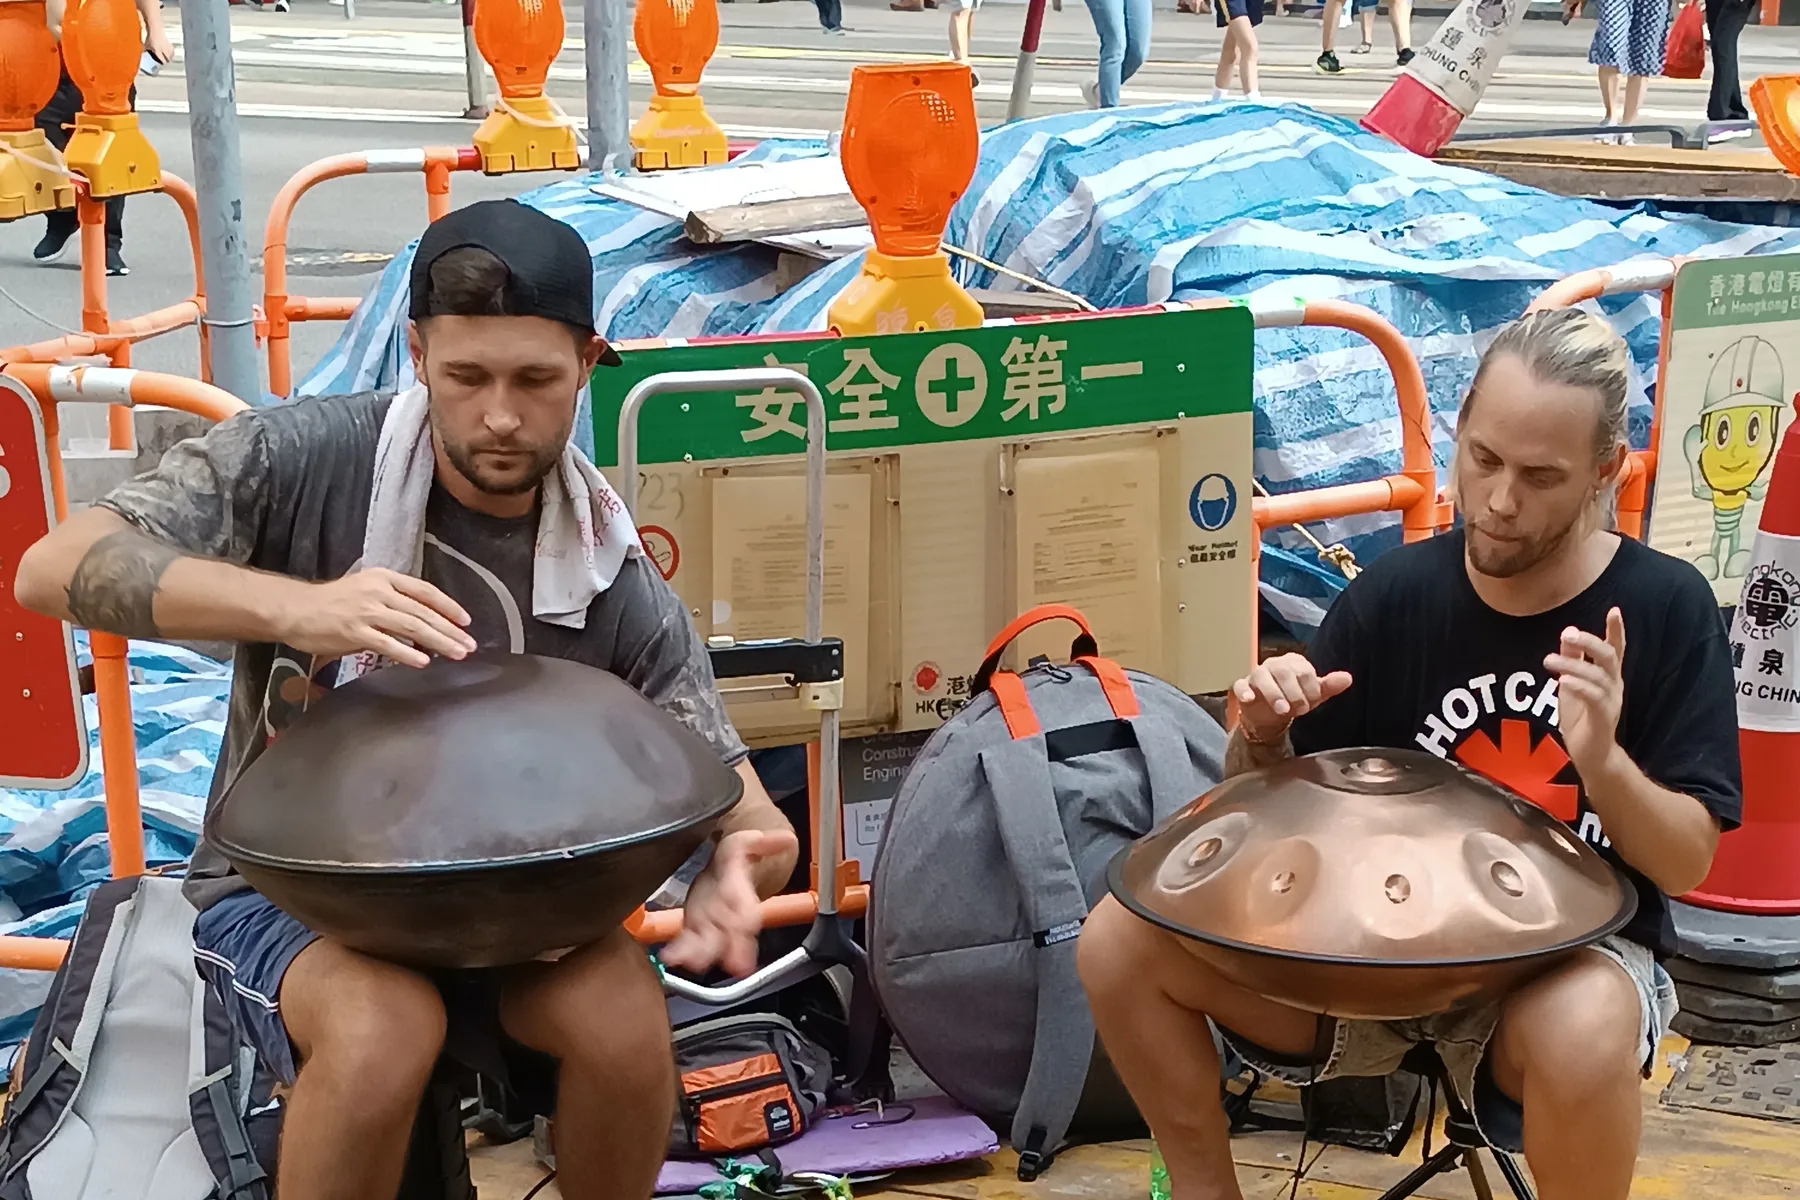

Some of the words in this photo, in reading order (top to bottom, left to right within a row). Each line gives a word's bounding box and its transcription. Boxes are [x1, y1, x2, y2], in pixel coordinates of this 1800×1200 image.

[735, 348, 902, 443] 安全
[1000, 334, 1144, 422] 第一
[1414, 673, 1497, 759] HOT
[1504, 671, 1560, 727] CH
